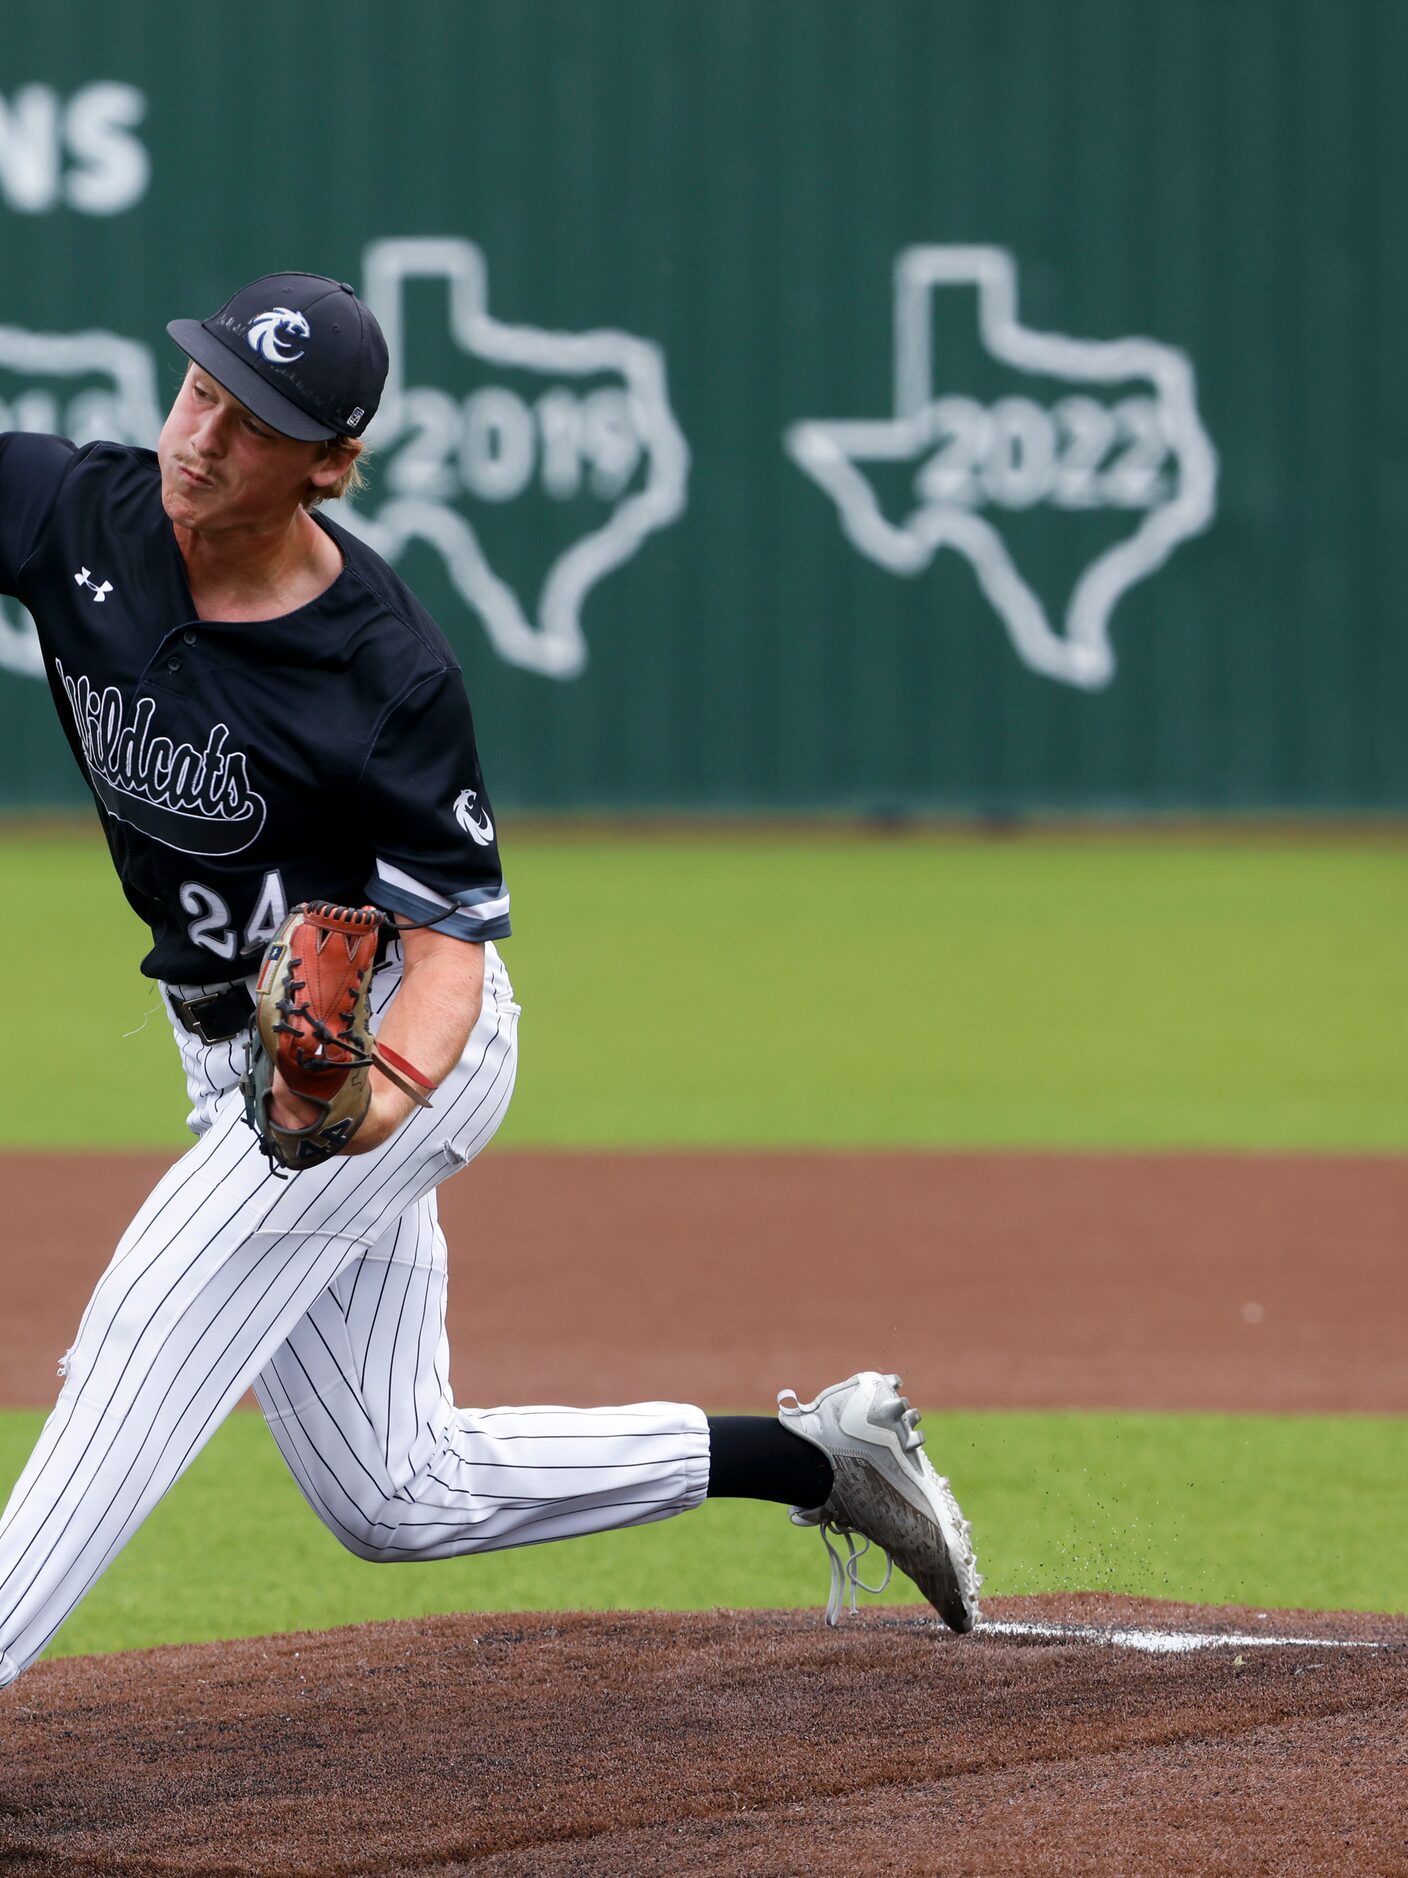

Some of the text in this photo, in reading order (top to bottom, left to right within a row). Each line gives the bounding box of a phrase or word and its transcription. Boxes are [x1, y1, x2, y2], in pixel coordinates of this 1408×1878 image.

[386, 386, 640, 500] 2019
[918, 396, 1170, 508] 2022
[55, 657, 256, 820] Wildcats
[180, 869, 290, 961] 24
